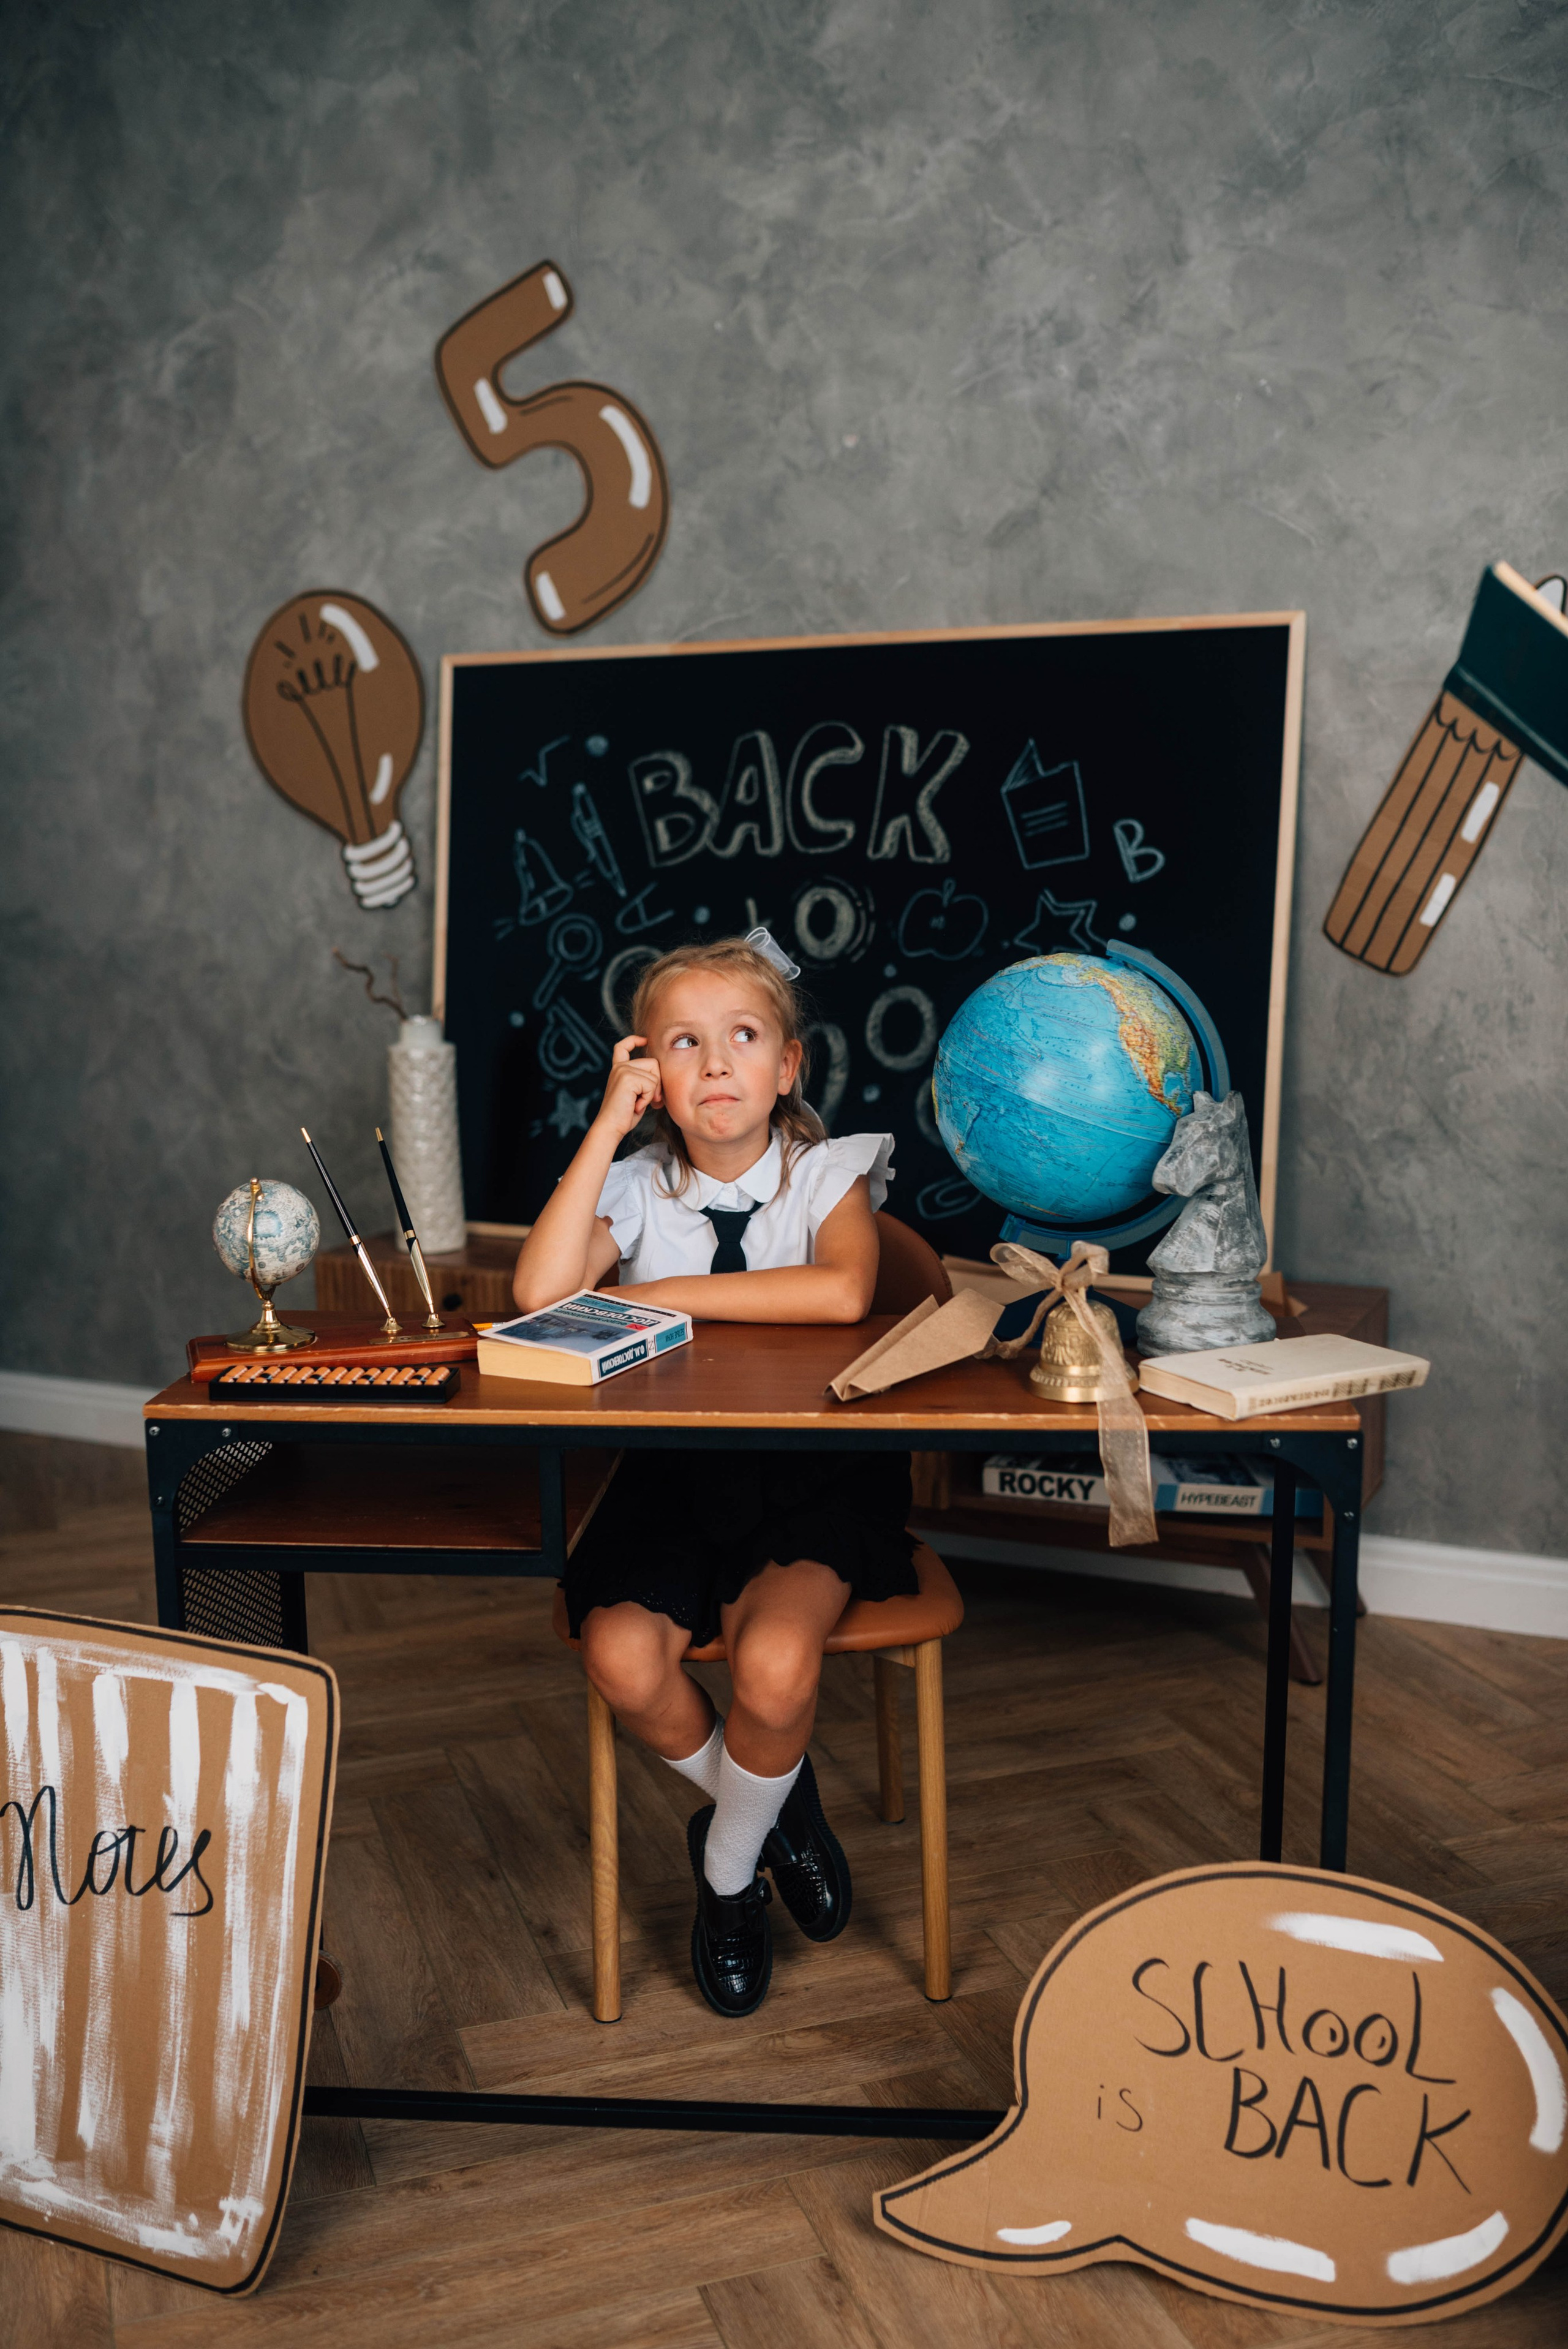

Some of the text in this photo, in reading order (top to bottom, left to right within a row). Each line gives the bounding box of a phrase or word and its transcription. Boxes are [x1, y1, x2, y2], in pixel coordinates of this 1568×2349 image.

[434, 259, 669, 637] 5
[628, 721, 969, 868] BACK
[1114, 818, 1165, 883] B
[563, 1303, 658, 1325] ДОСТОЕВСКИЙ
[601, 1348, 634, 1373] ДОСТОЕВСКИЙ
[998, 1471, 1095, 1501] ROCKY
[1180, 1493, 1259, 1509] HYPEBEAST
[0, 1785, 214, 1917] Notes
[1098, 2067, 1472, 2195] is BACK
